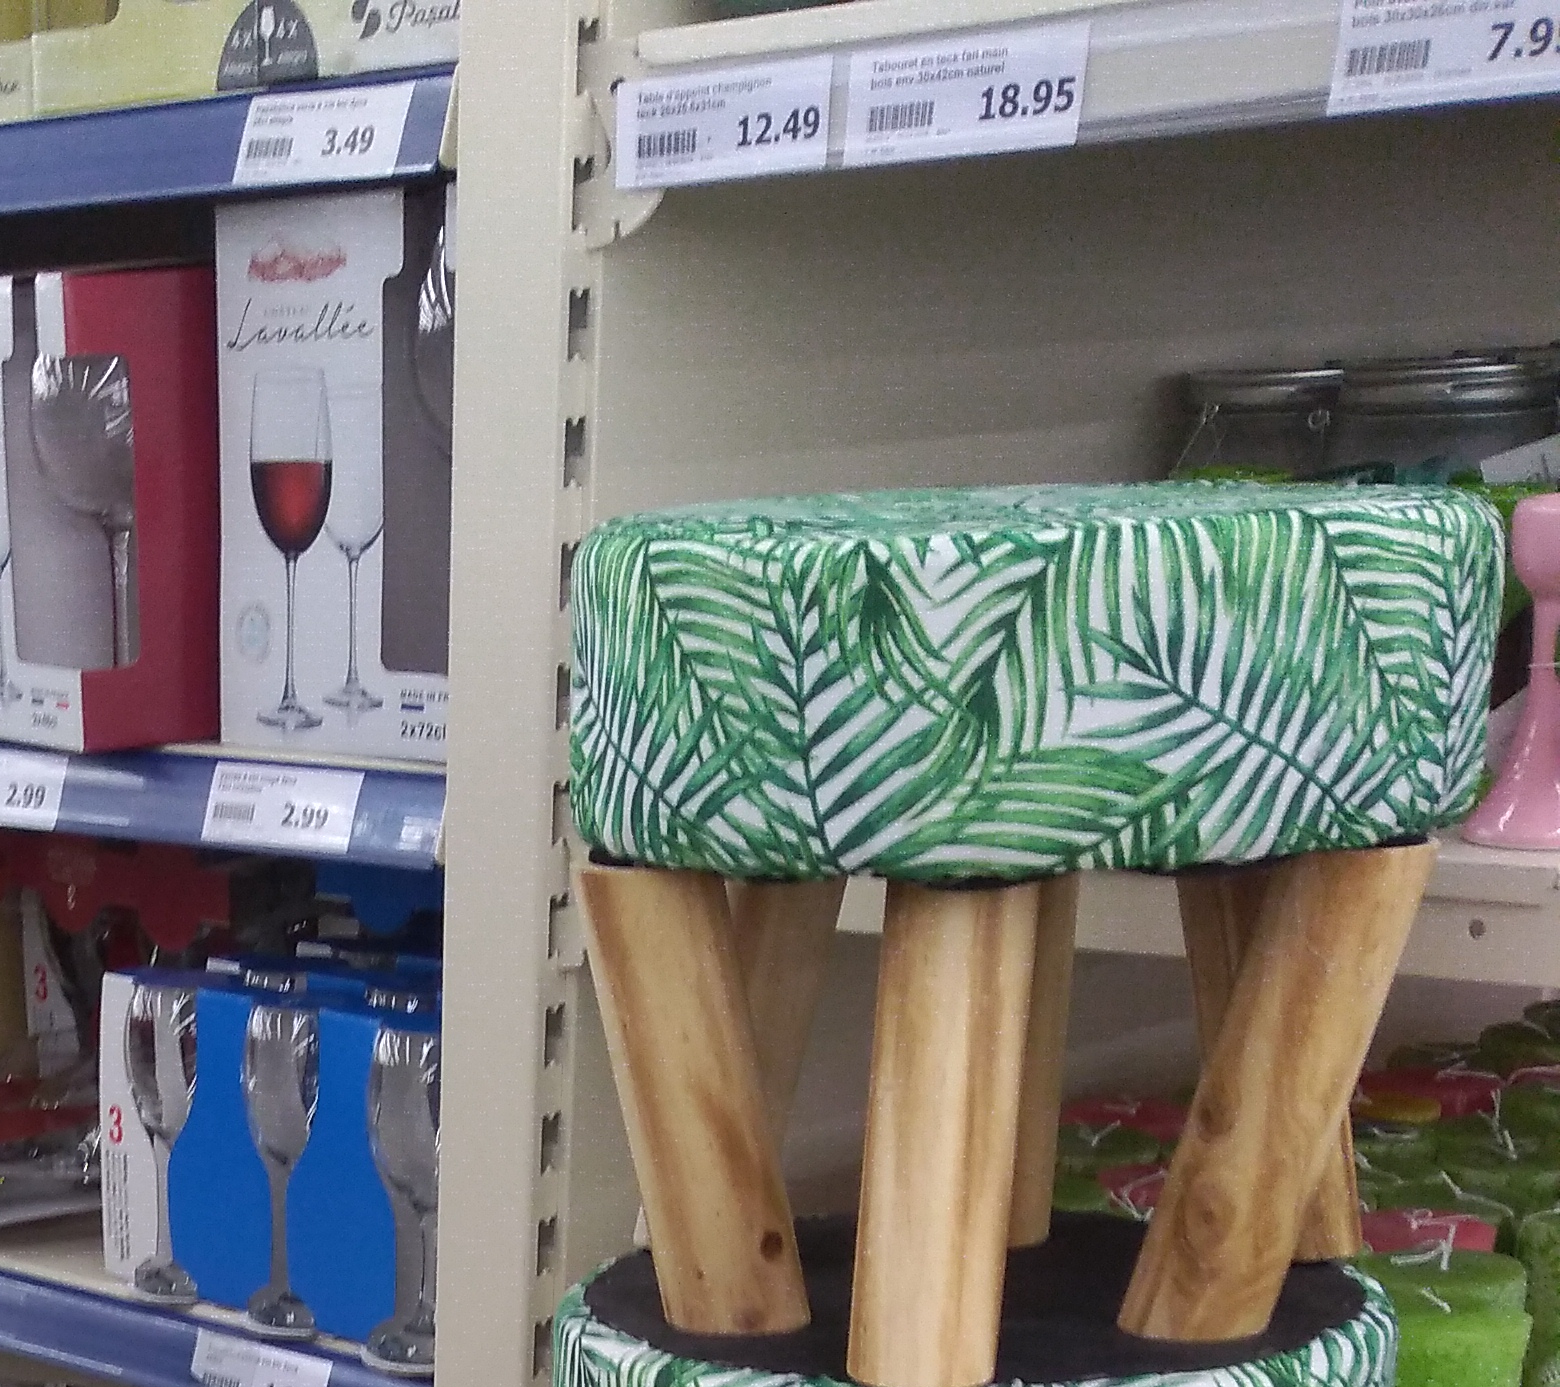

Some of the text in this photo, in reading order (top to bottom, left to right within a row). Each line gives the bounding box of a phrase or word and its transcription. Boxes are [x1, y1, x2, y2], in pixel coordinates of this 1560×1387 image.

[1487, 17, 1560, 61] 7.9
[978, 76, 1076, 120] 18.95
[321, 125, 376, 156] 3.49
[736, 104, 820, 147] 12.49
[227, 298, 374, 352] Lavallée
[4, 783, 47, 809] 2.99
[281, 802, 330, 830] 2.99
[108, 1104, 123, 1145] 3
